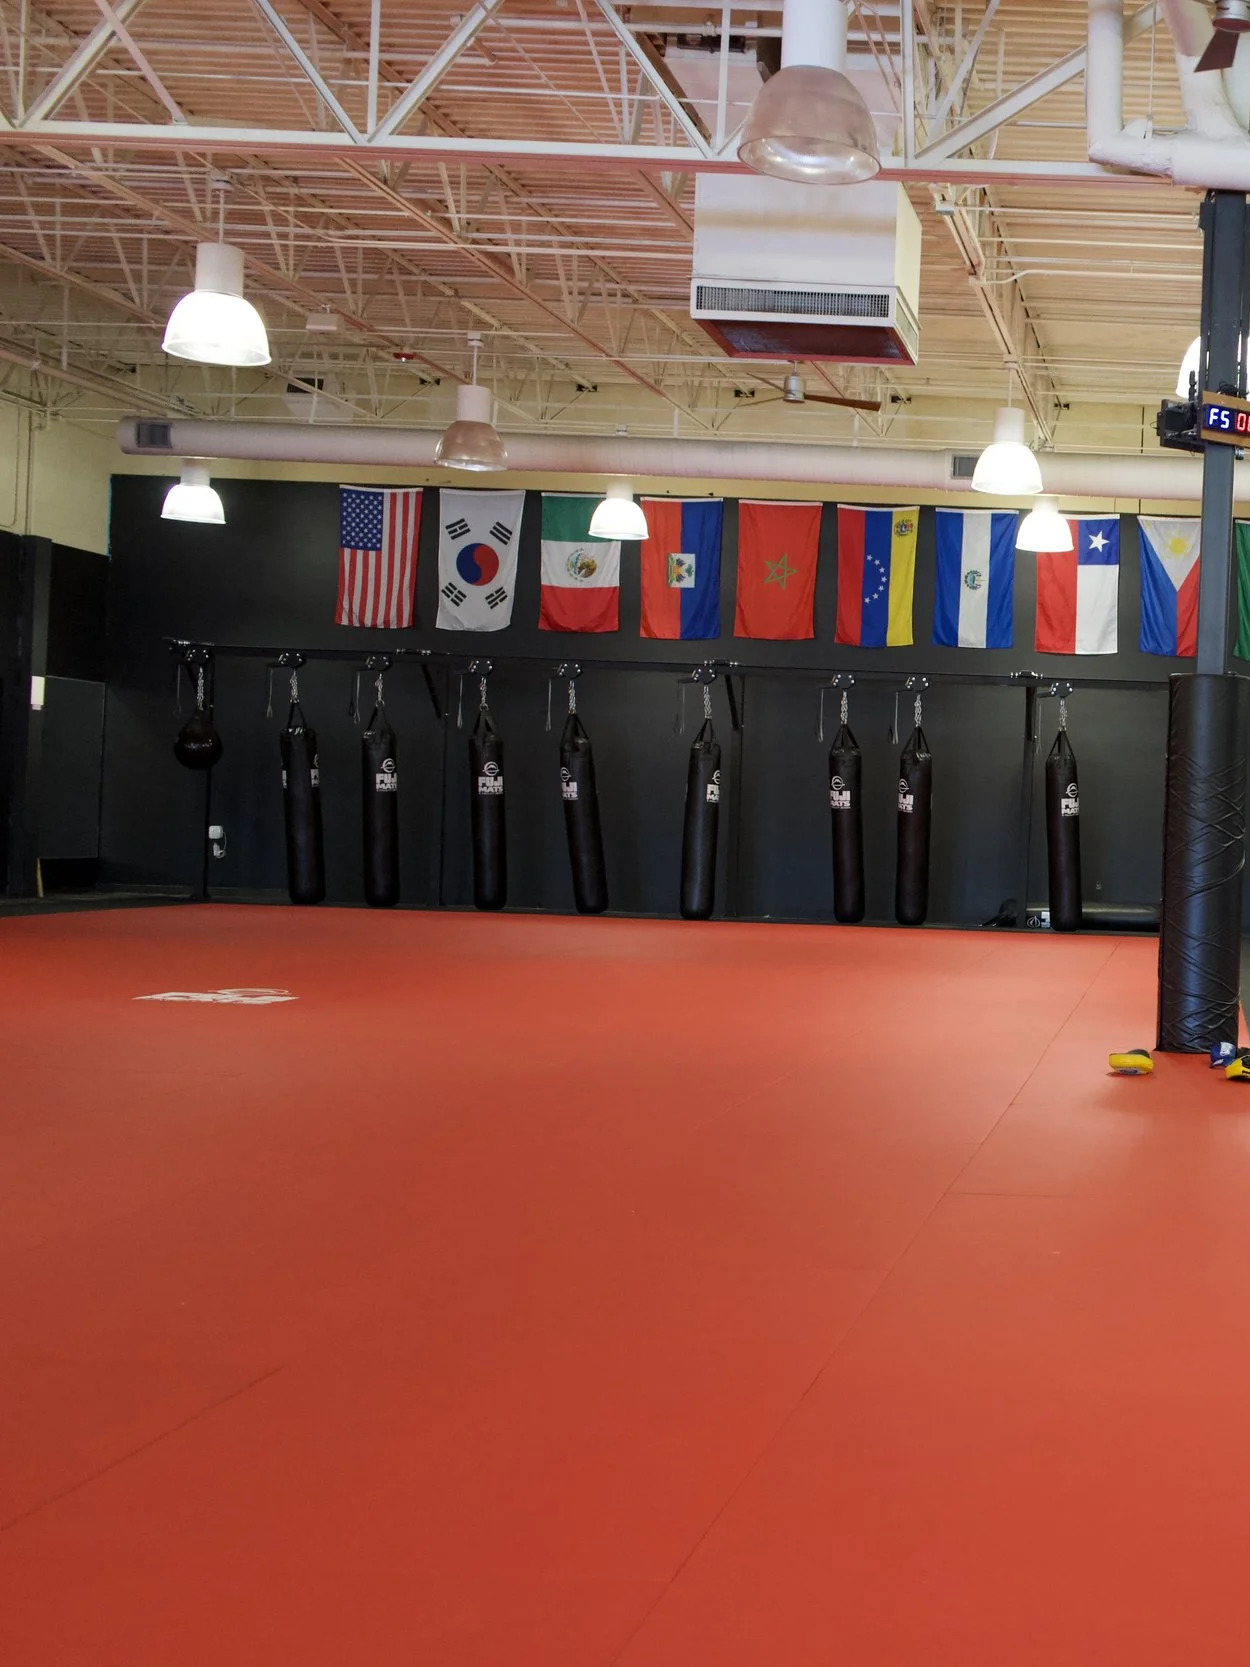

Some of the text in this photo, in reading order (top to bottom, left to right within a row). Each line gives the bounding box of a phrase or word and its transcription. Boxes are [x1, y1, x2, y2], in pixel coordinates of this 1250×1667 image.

[375, 773, 397, 784] FUJ
[478, 776, 503, 787] FUJI
[561, 781, 578, 792] UJI
[898, 793, 914, 804] UJI
